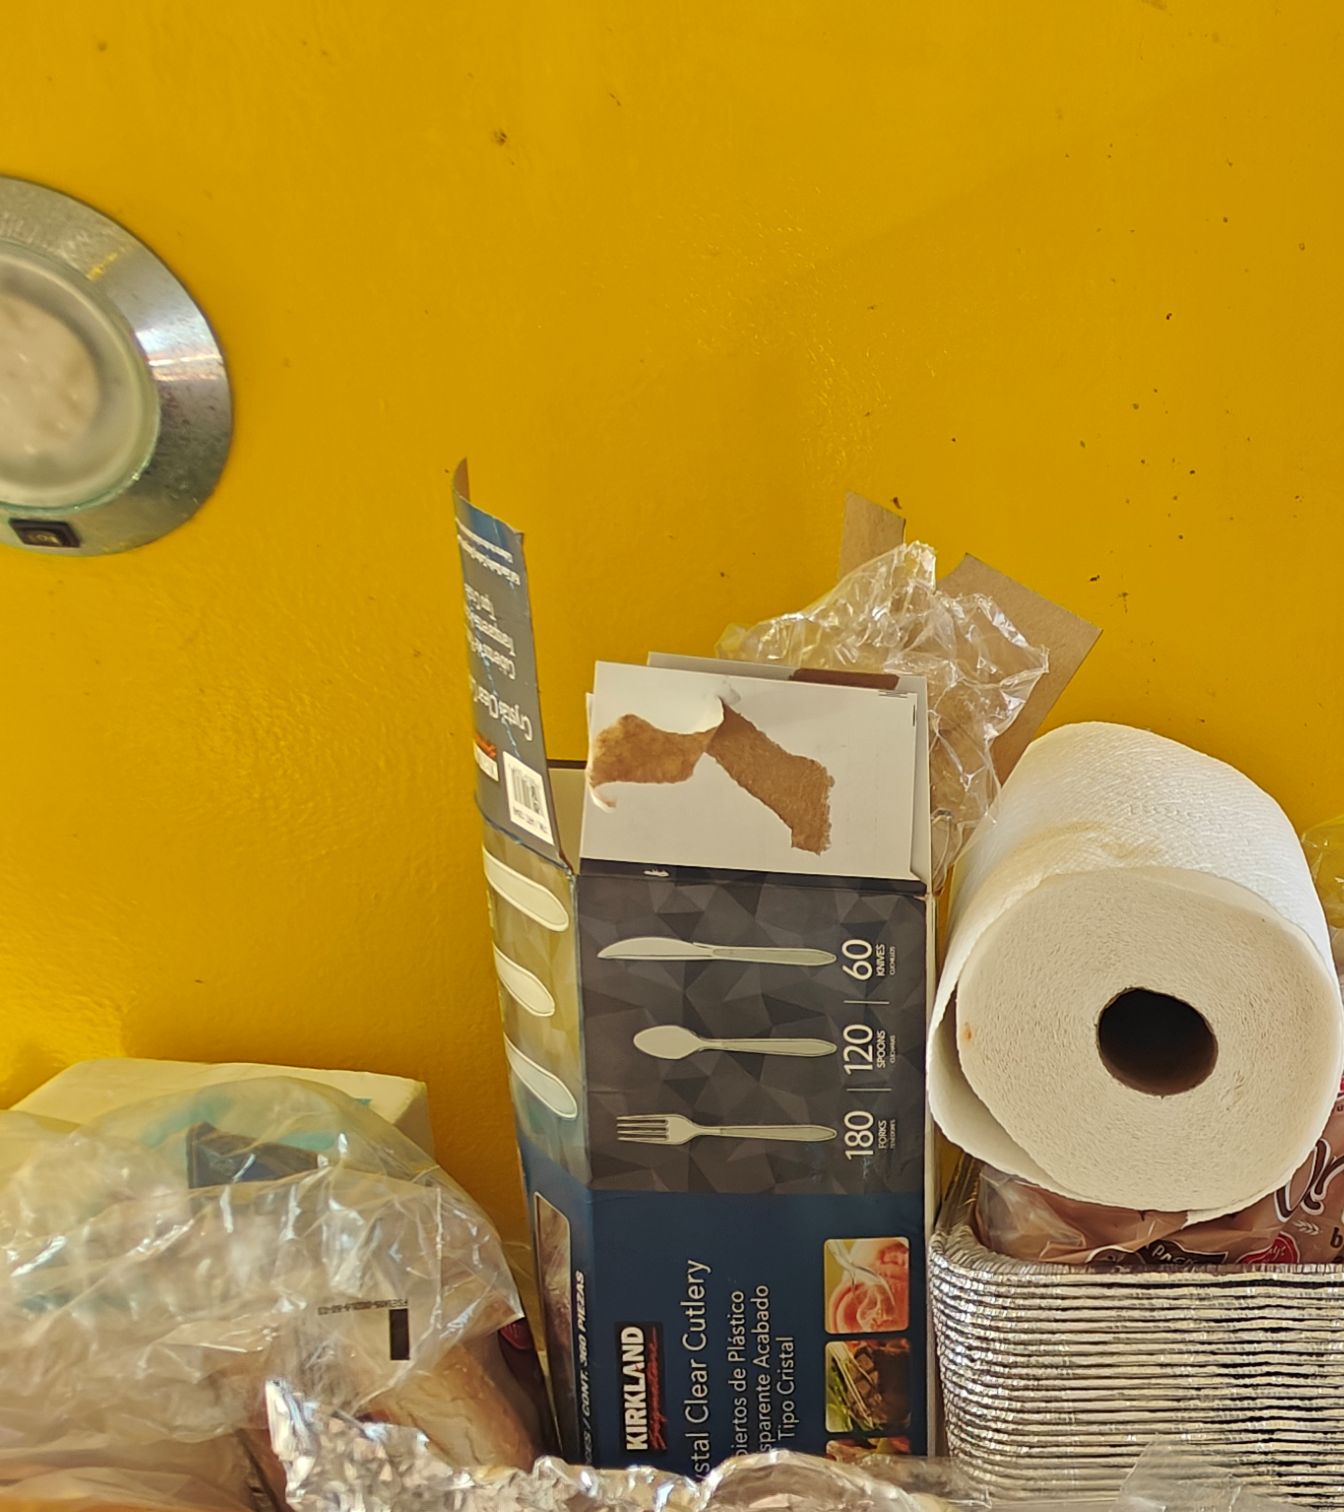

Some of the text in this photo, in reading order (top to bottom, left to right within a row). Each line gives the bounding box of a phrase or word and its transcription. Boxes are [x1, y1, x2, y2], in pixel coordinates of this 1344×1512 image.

[842, 939, 873, 980] 60
[876, 944, 887, 976] KNIVES
[842, 1024, 874, 1076] 120
[876, 1031, 887, 1068] SPOONS
[843, 1111, 874, 1161] 180
[877, 1120, 888, 1149] FORKS
[574, 1270, 588, 1332] PIEZAS
[680, 1259, 711, 1351] Cutlery
[727, 1290, 746, 1362] Plástico
[577, 1370, 591, 1415] CONT.
[621, 1326, 648, 1450] KIRKLAND
[684, 1359, 709, 1423] Clear
[728, 1367, 747, 1393] de
[750, 1284, 777, 1453] sparente Acabado
[775, 1336, 800, 1440] Tipo Cristal
